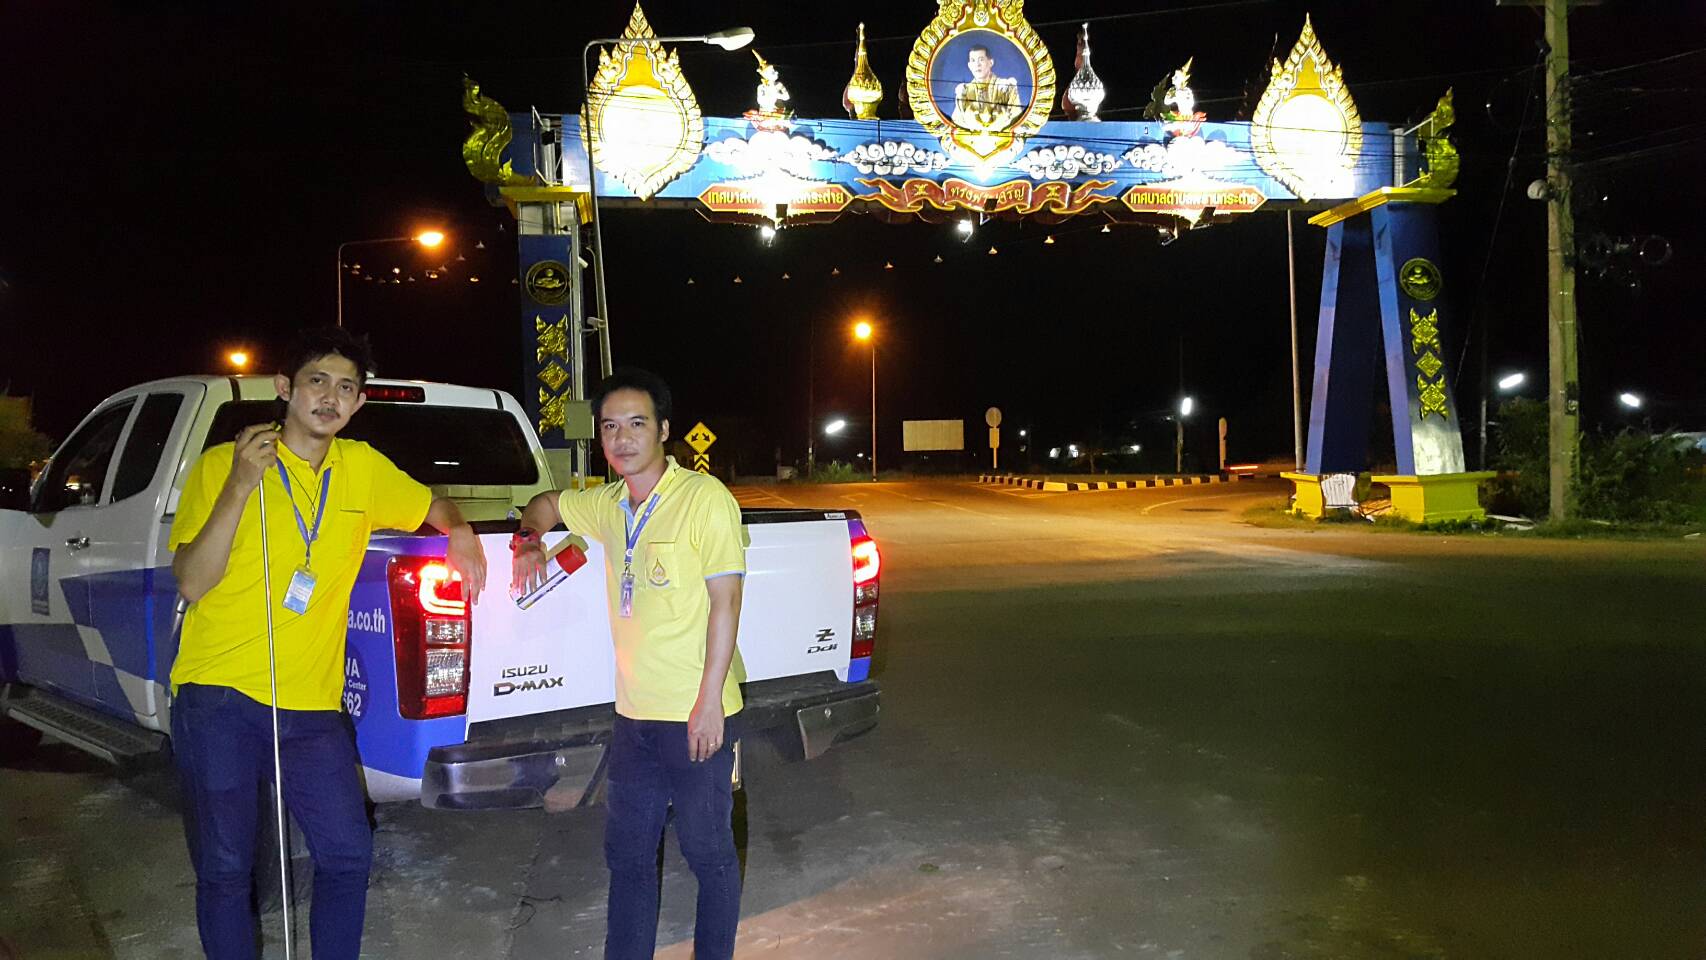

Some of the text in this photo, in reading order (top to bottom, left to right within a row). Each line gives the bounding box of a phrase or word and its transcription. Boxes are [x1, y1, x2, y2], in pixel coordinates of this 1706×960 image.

[807, 643, 838, 654] Ddi
[502, 664, 548, 679] ISUZU
[494, 677, 563, 696] D-MAX
